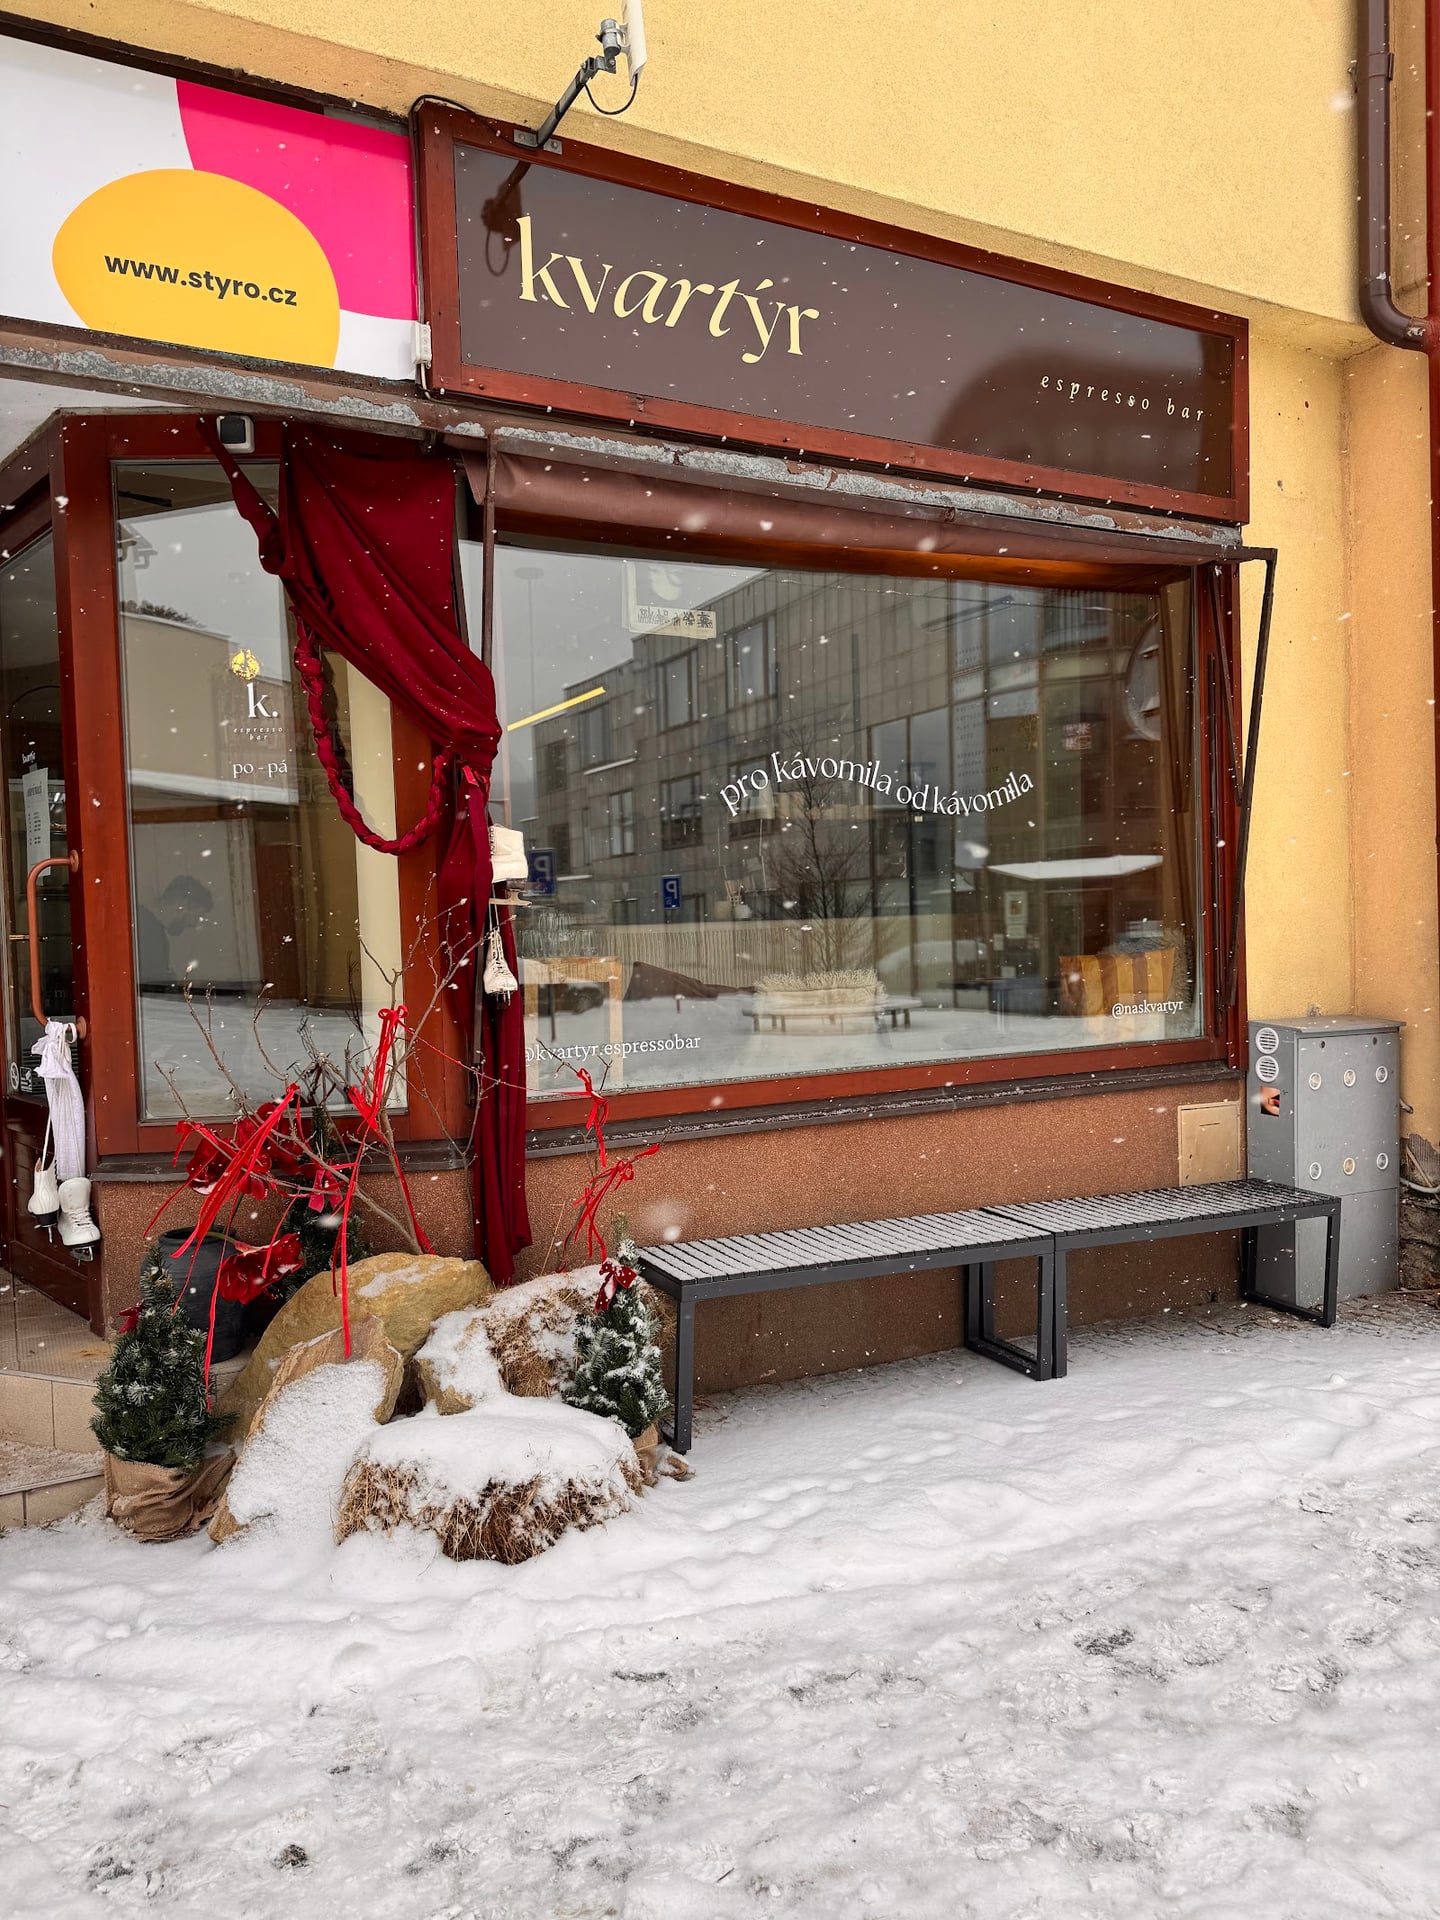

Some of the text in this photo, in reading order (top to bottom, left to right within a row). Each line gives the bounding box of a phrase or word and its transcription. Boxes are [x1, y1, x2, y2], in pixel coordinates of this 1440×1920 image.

[104, 255, 298, 307] www.styro.cz
[516, 215, 820, 364] kvartýr
[1040, 375, 1204, 422] espresso bar
[246, 681, 279, 719] k.
[232, 762, 254, 779] po
[267, 759, 288, 778] pá
[719, 751, 1035, 817] pro kávomila od kávomila
[1111, 999, 1184, 1020] @naskvartyr
